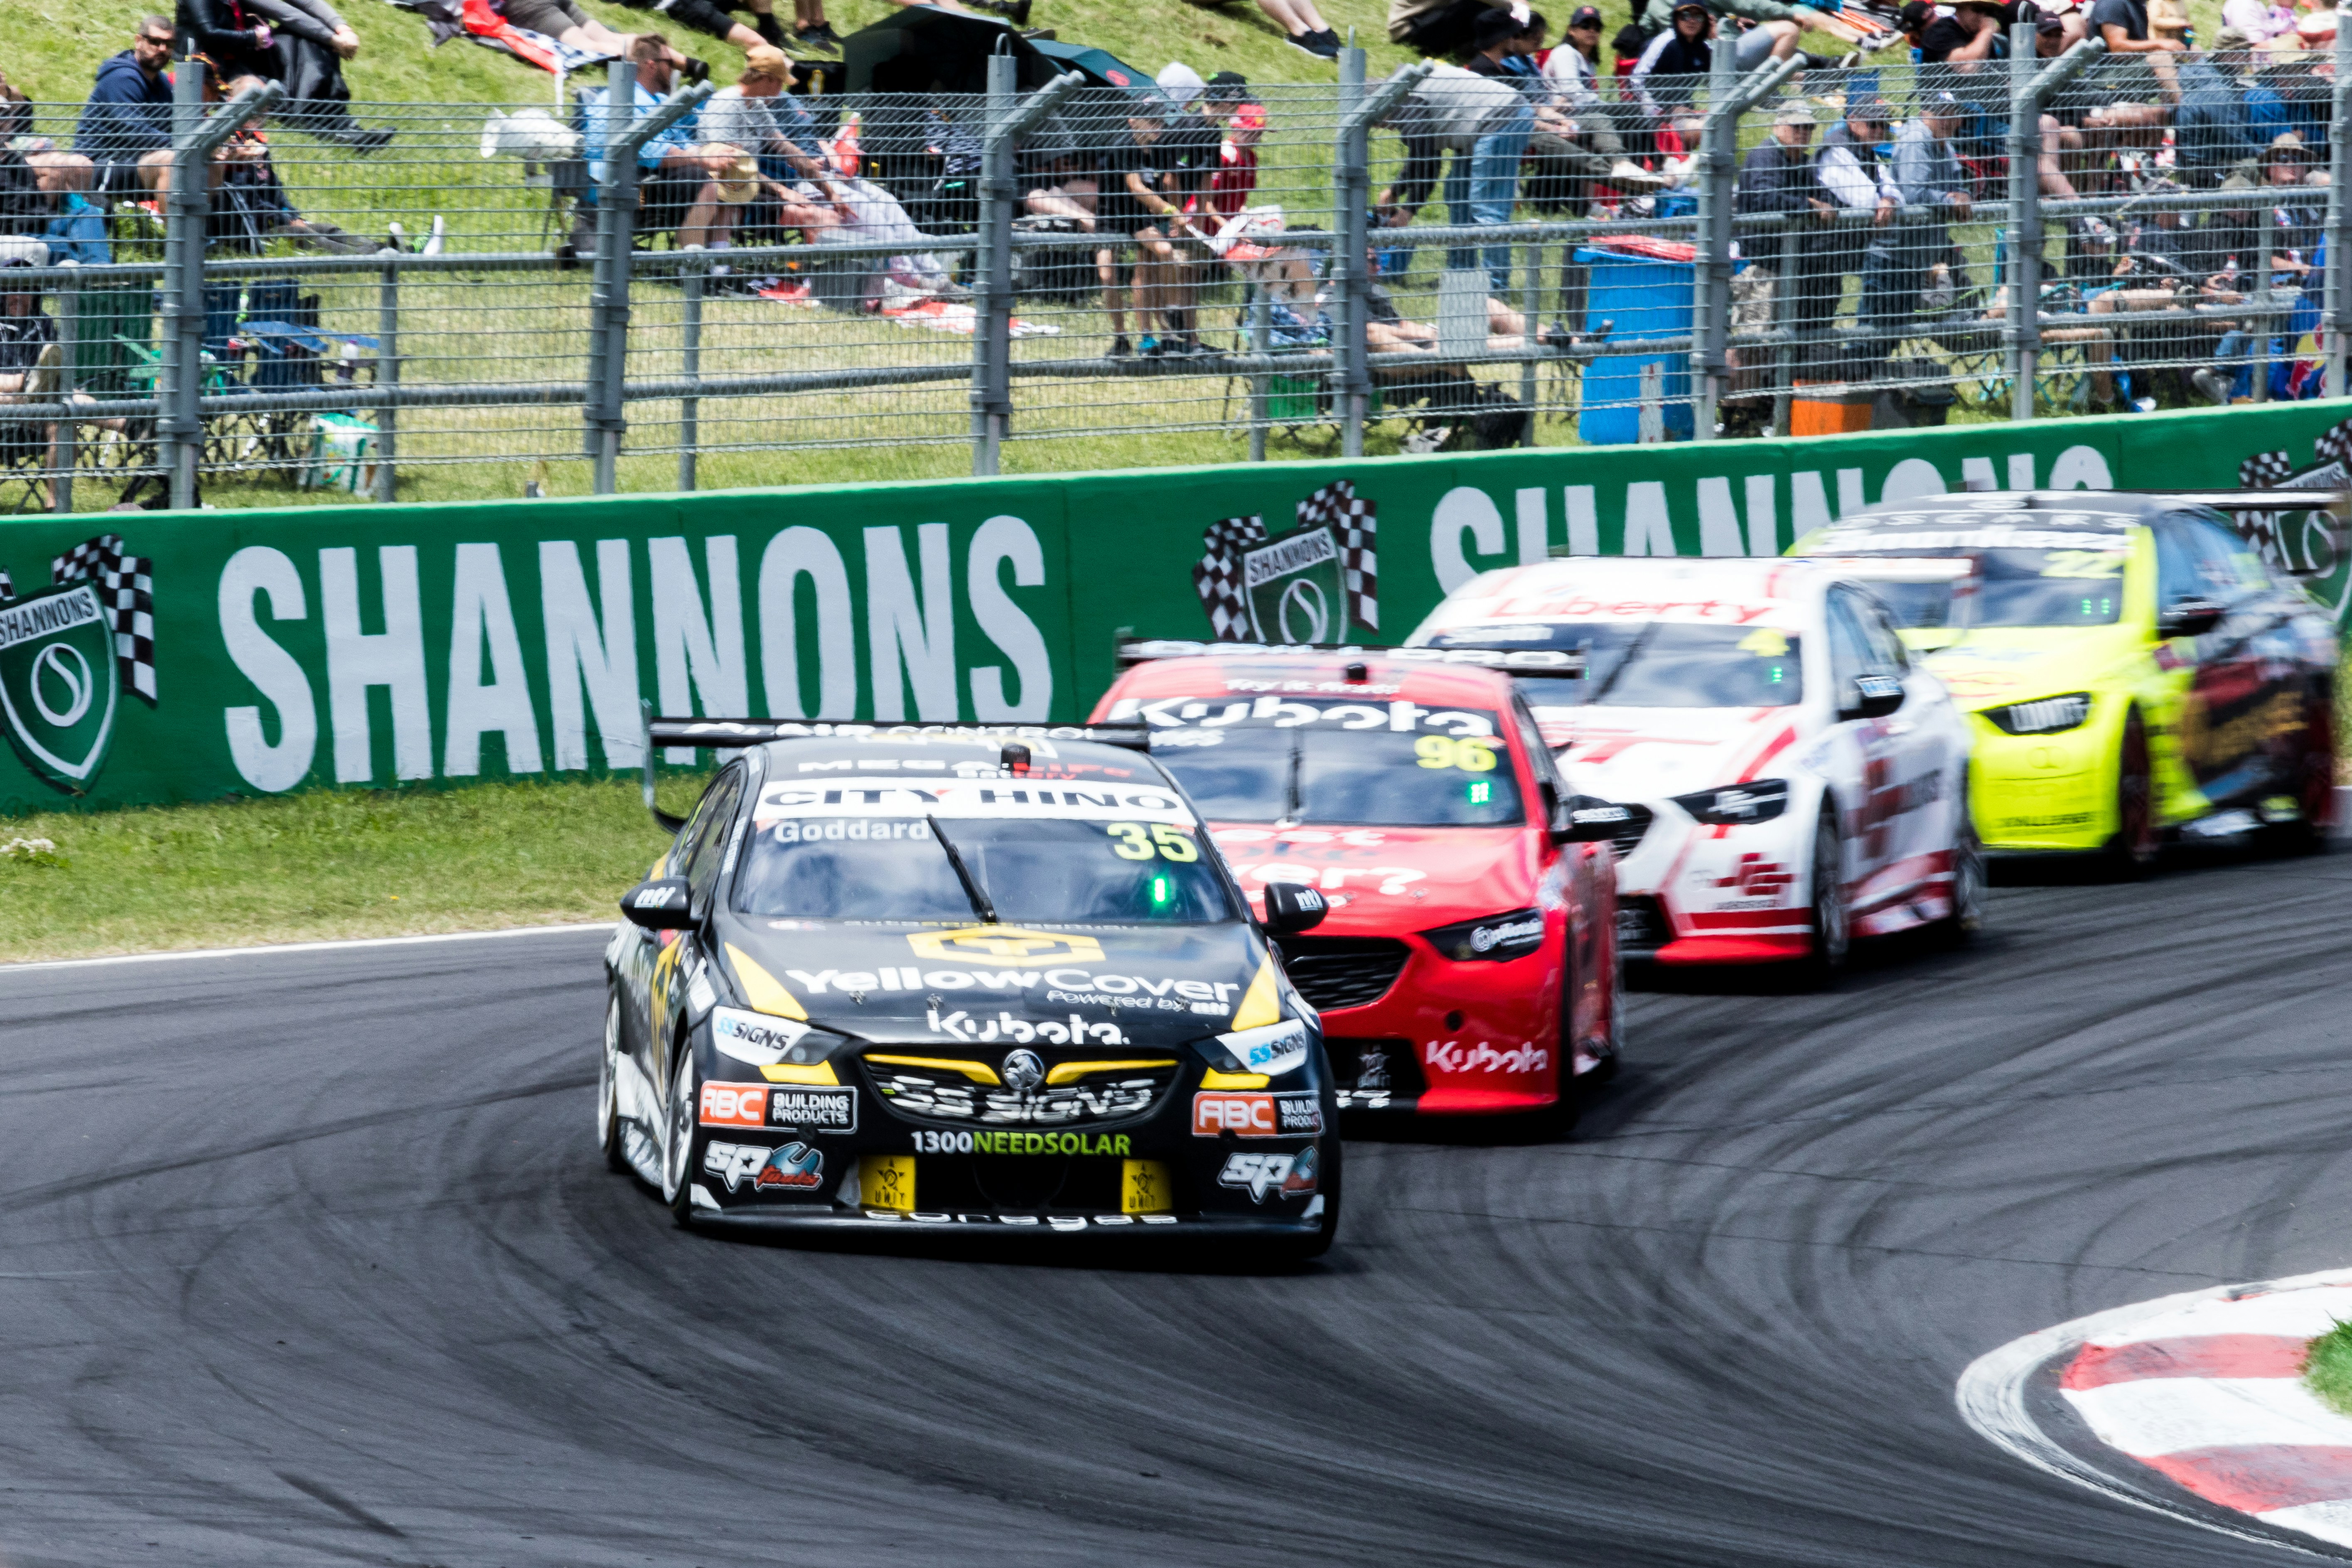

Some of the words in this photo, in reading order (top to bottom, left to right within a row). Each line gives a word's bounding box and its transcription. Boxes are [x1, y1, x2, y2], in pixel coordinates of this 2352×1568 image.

[1488, 596, 1773, 623] Liberty
[217, 515, 1052, 793] SHANNONS
[1106, 696, 1494, 737] Kubota
[887, 725, 1108, 740] CONTROL
[1414, 735, 1497, 772] 96
[763, 789, 954, 806] CITY
[979, 789, 1179, 811] HINO
[774, 819, 931, 843] Goddard
[1107, 821, 1199, 864] 35
[1212, 829, 1386, 846] est
[785, 966, 1240, 1002] YellowCover
[1047, 990, 1153, 1008] Powered
[1426, 1040, 1549, 1073] Kubota
[700, 1088, 763, 1121] ABC
[773, 1092, 850, 1111] BUILDING
[1199, 1099, 1273, 1129] ABC
[772, 1108, 849, 1124] PRODUCTS
[875, 1190, 906, 1206] UNIT
